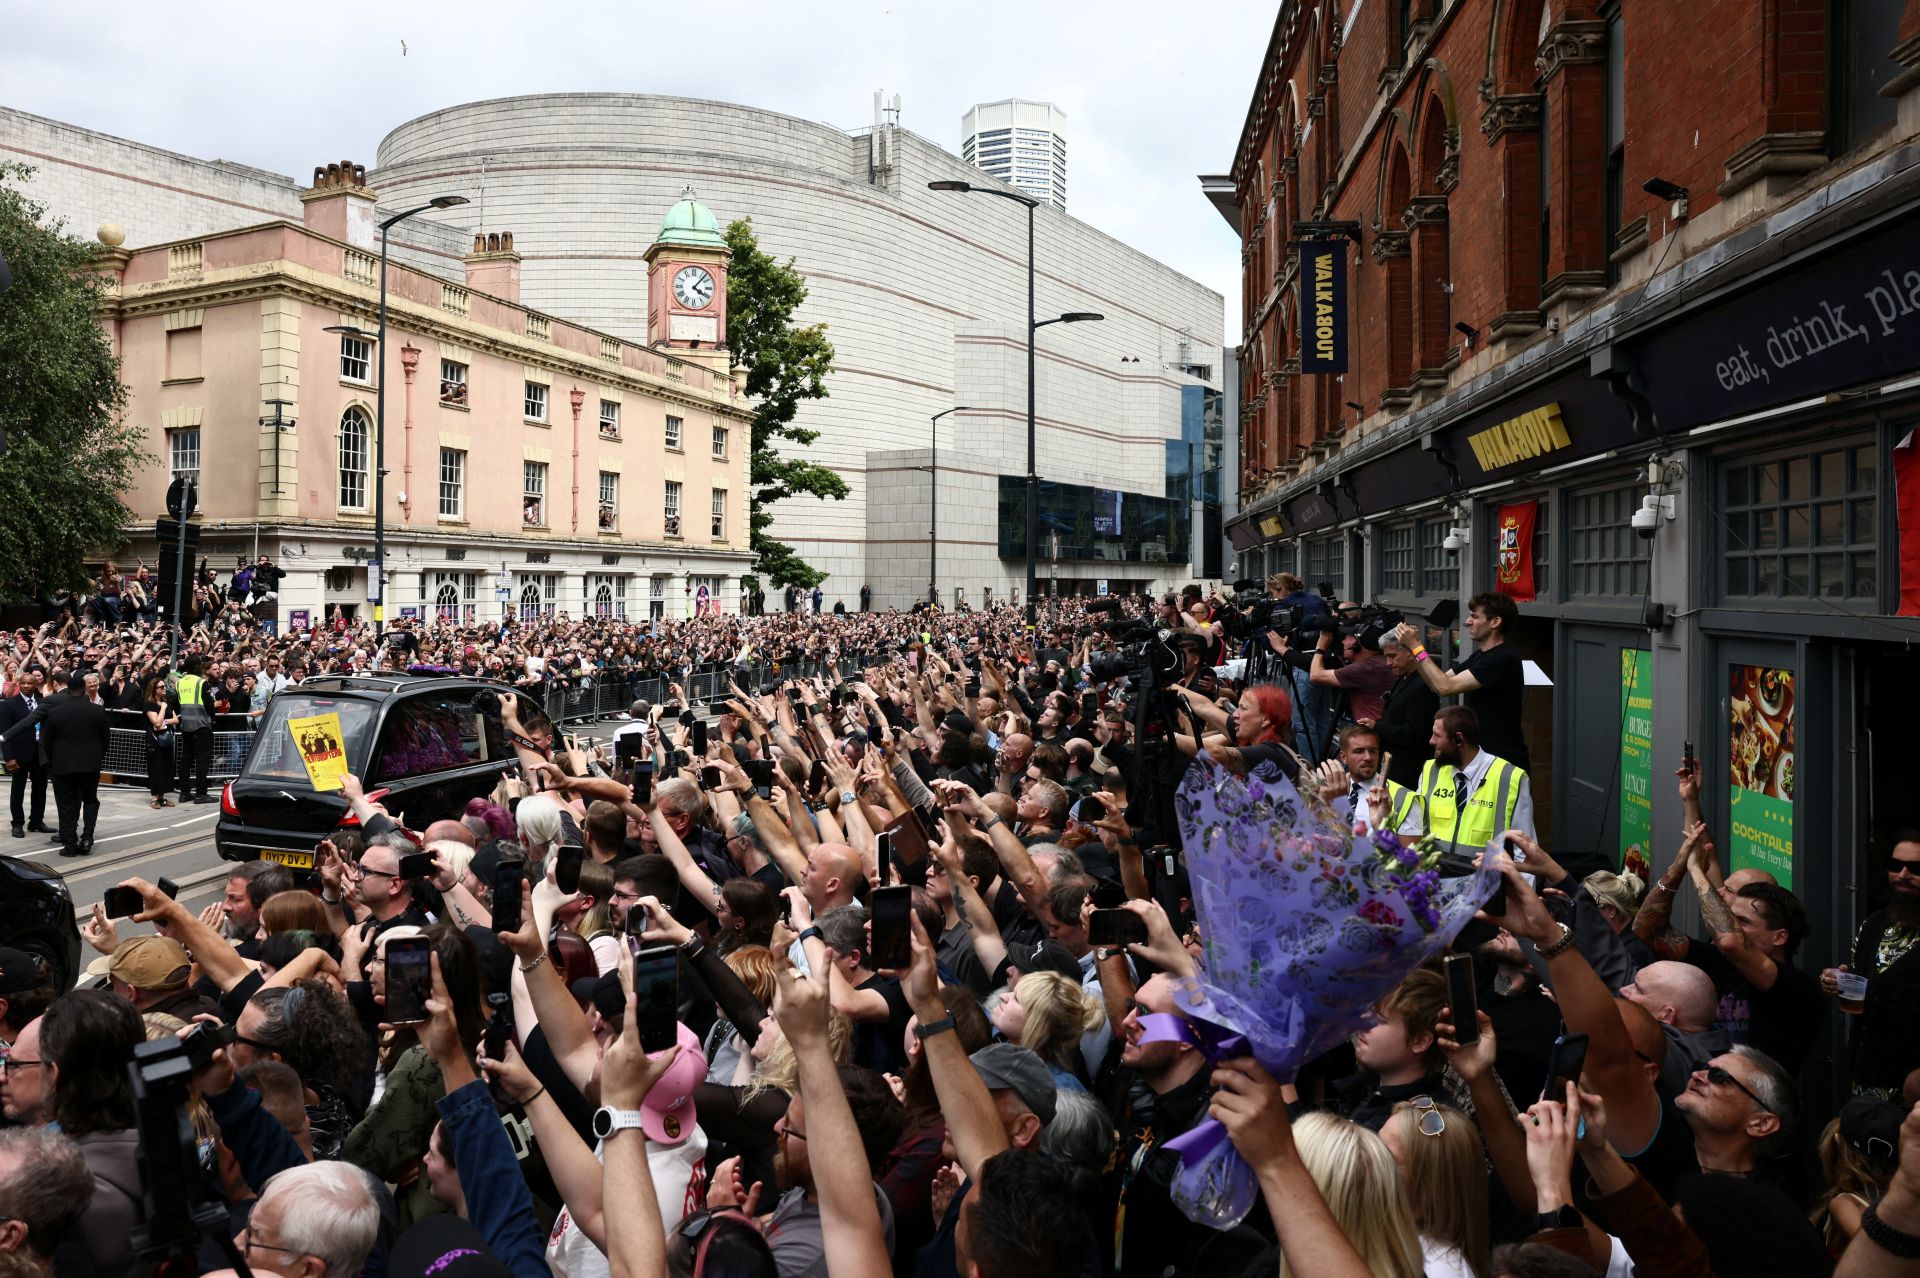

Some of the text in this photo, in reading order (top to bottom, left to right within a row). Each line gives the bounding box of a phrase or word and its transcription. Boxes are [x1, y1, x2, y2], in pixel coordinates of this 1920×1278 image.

[1315, 253, 1334, 361] WALKABOUT
[1716, 343, 1770, 391] eat,
[1766, 300, 1870, 369] drink,
[1467, 401, 1572, 472] WALKABOUT
[292, 618, 306, 627] 50%
[1629, 716, 1652, 739] BURGE
[1433, 788, 1455, 798] 434
[1624, 772, 1647, 797] LUNCH
[1732, 822, 1792, 855] COCKTAILS
[287, 854, 307, 866] DVJ
[1756, 845, 1767, 864] Day
